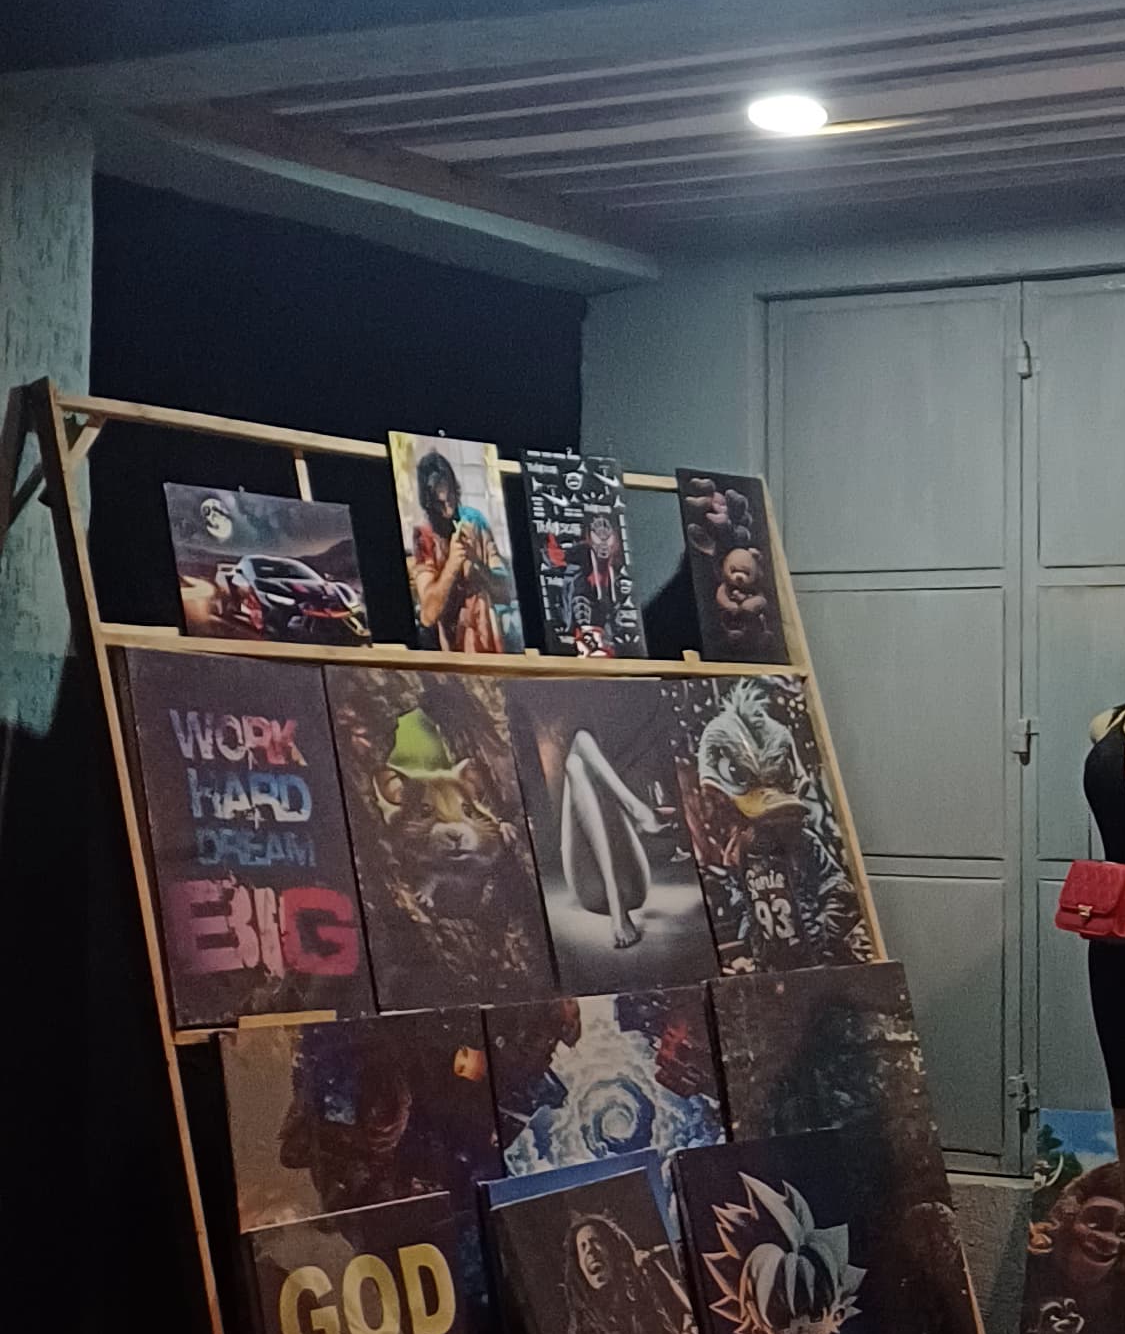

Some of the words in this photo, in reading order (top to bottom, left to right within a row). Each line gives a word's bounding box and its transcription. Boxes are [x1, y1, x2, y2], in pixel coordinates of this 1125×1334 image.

[169, 708, 308, 768] WORK
[187, 767, 312, 823] HARD
[196, 827, 316, 867] DREAM
[168, 878, 360, 979] BIG
[754, 898, 796, 940] 93
